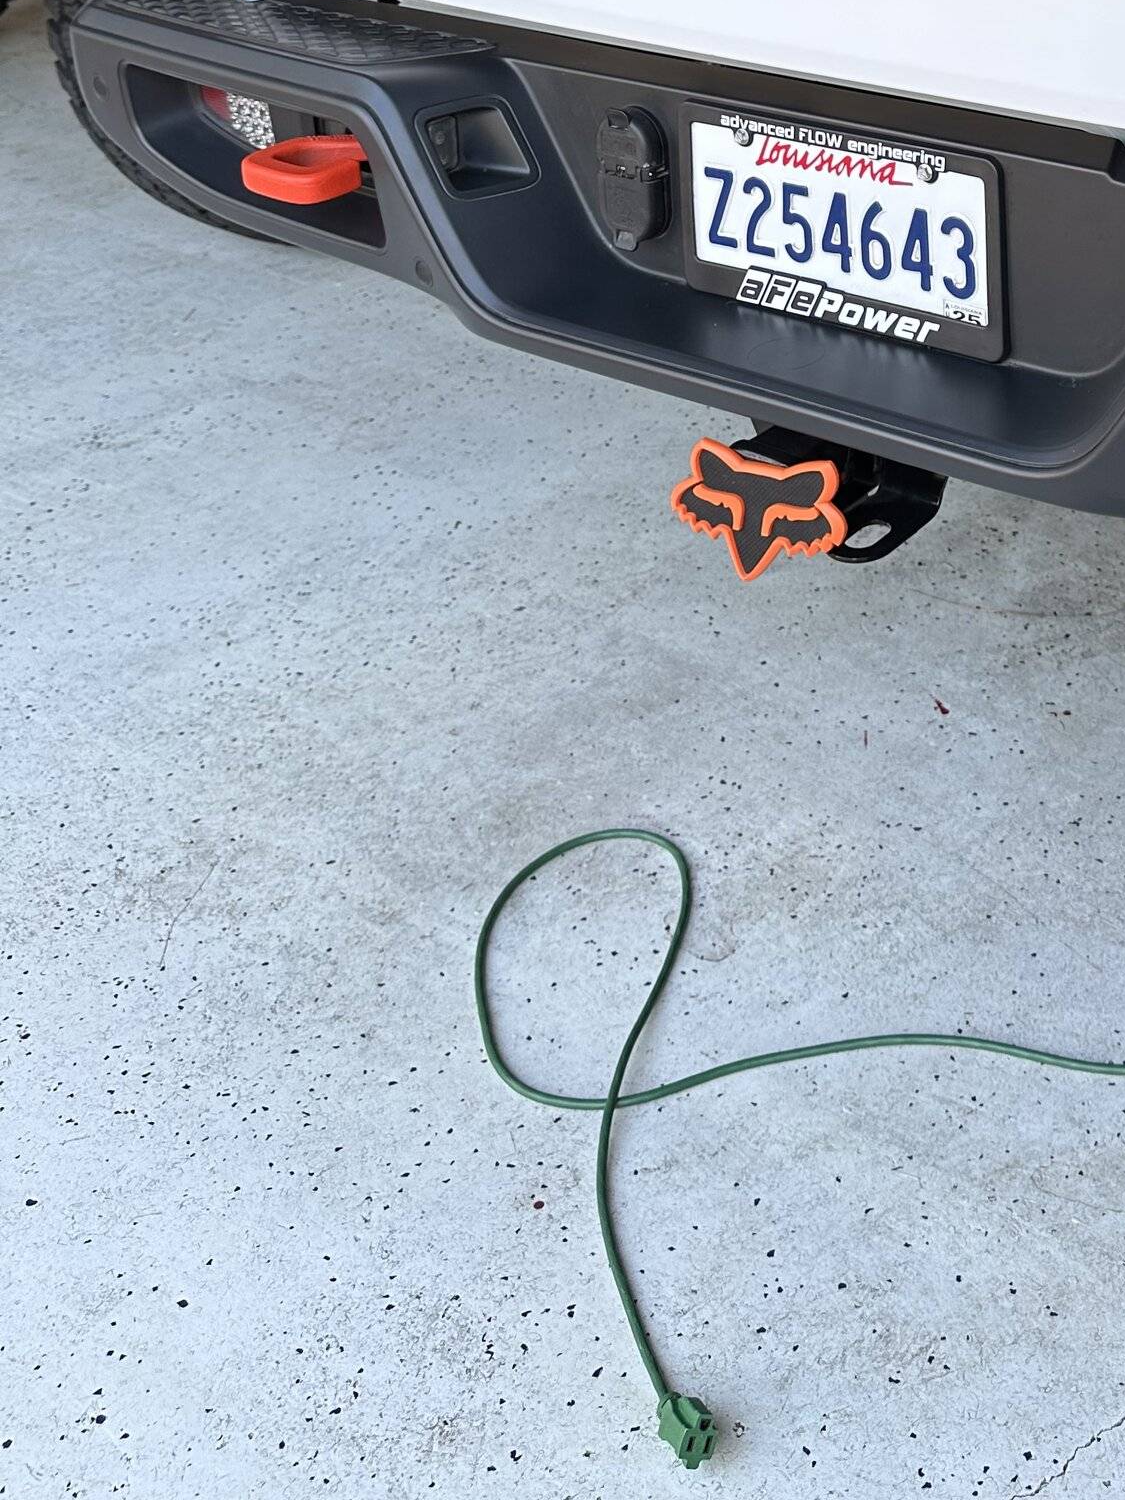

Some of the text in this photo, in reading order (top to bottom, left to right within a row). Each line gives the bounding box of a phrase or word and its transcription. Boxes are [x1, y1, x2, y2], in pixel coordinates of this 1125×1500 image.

[720, 114, 946, 172] advanced FLOW engineering
[755, 136, 914, 187] Louisiana
[704, 167, 977, 300] Z254643
